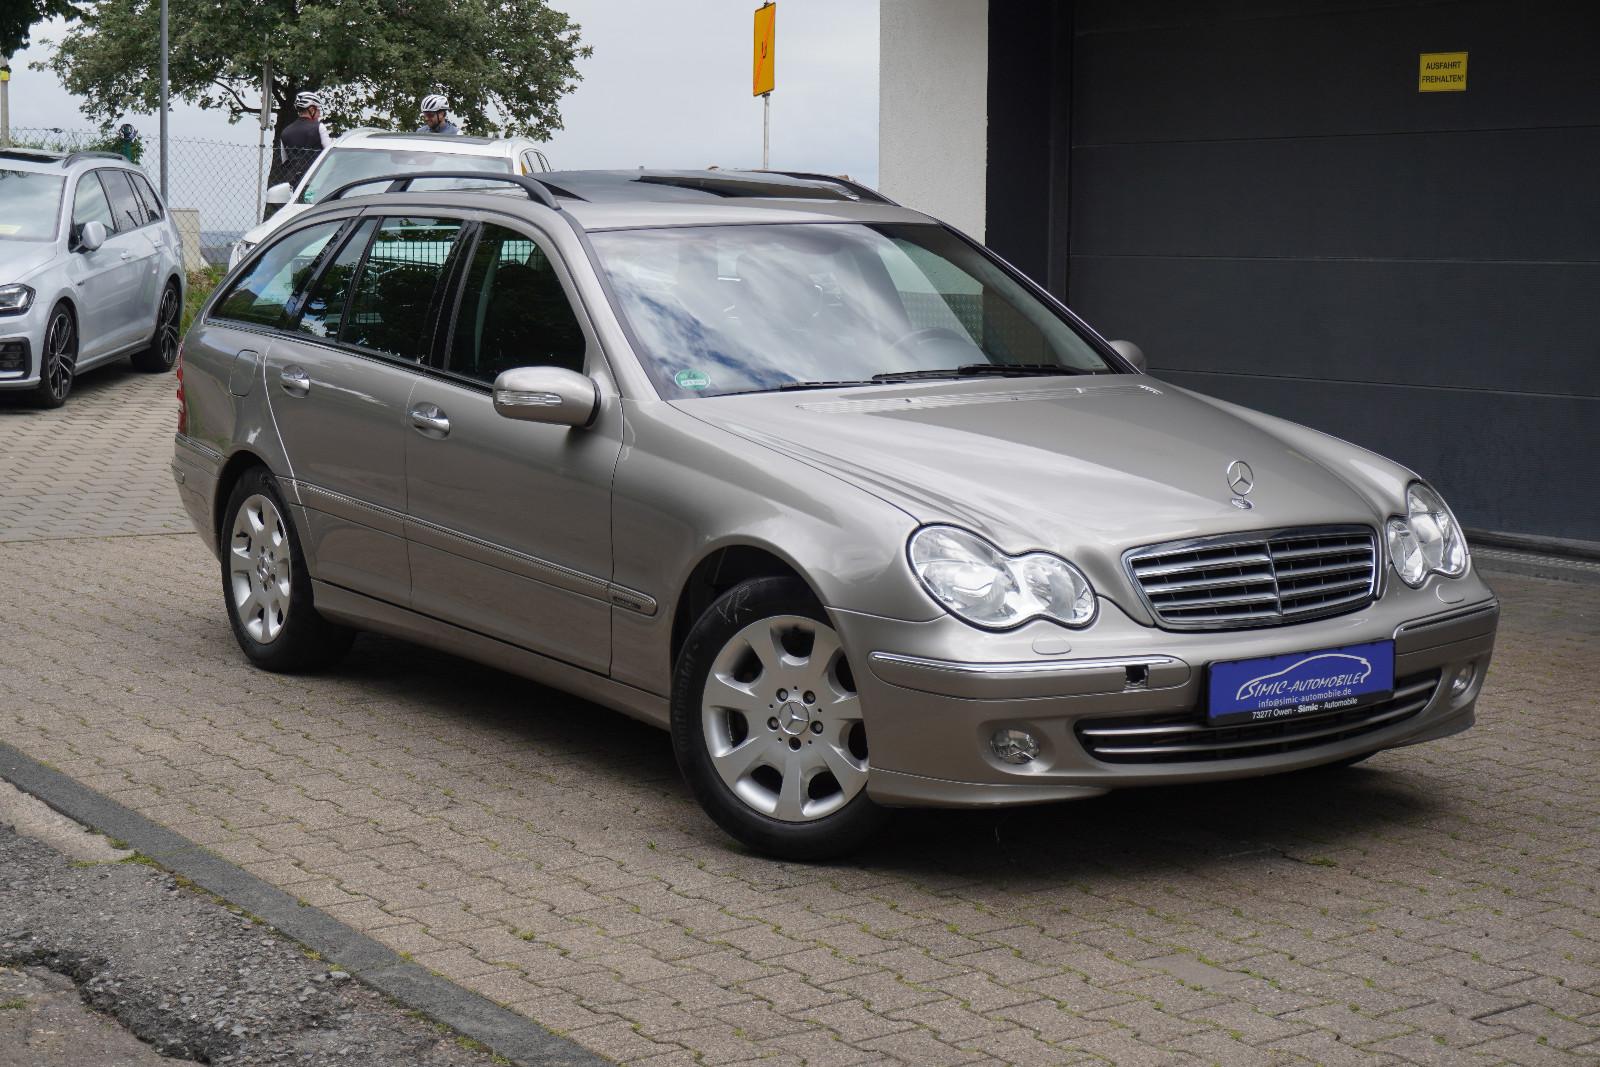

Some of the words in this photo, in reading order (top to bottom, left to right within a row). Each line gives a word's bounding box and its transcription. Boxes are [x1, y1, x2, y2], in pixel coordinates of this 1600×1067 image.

[1426, 61, 1461, 70] AUSFAHRT
[1421, 74, 1464, 83] FREIHALTEN!
[1258, 688, 1352, 708] info@simic-automobile.de
[1252, 709, 1272, 719] 73277
[1273, 708, 1292, 717] Owen
[1297, 704, 1319, 713] Simic
[1324, 697, 1358, 709] Automobile
